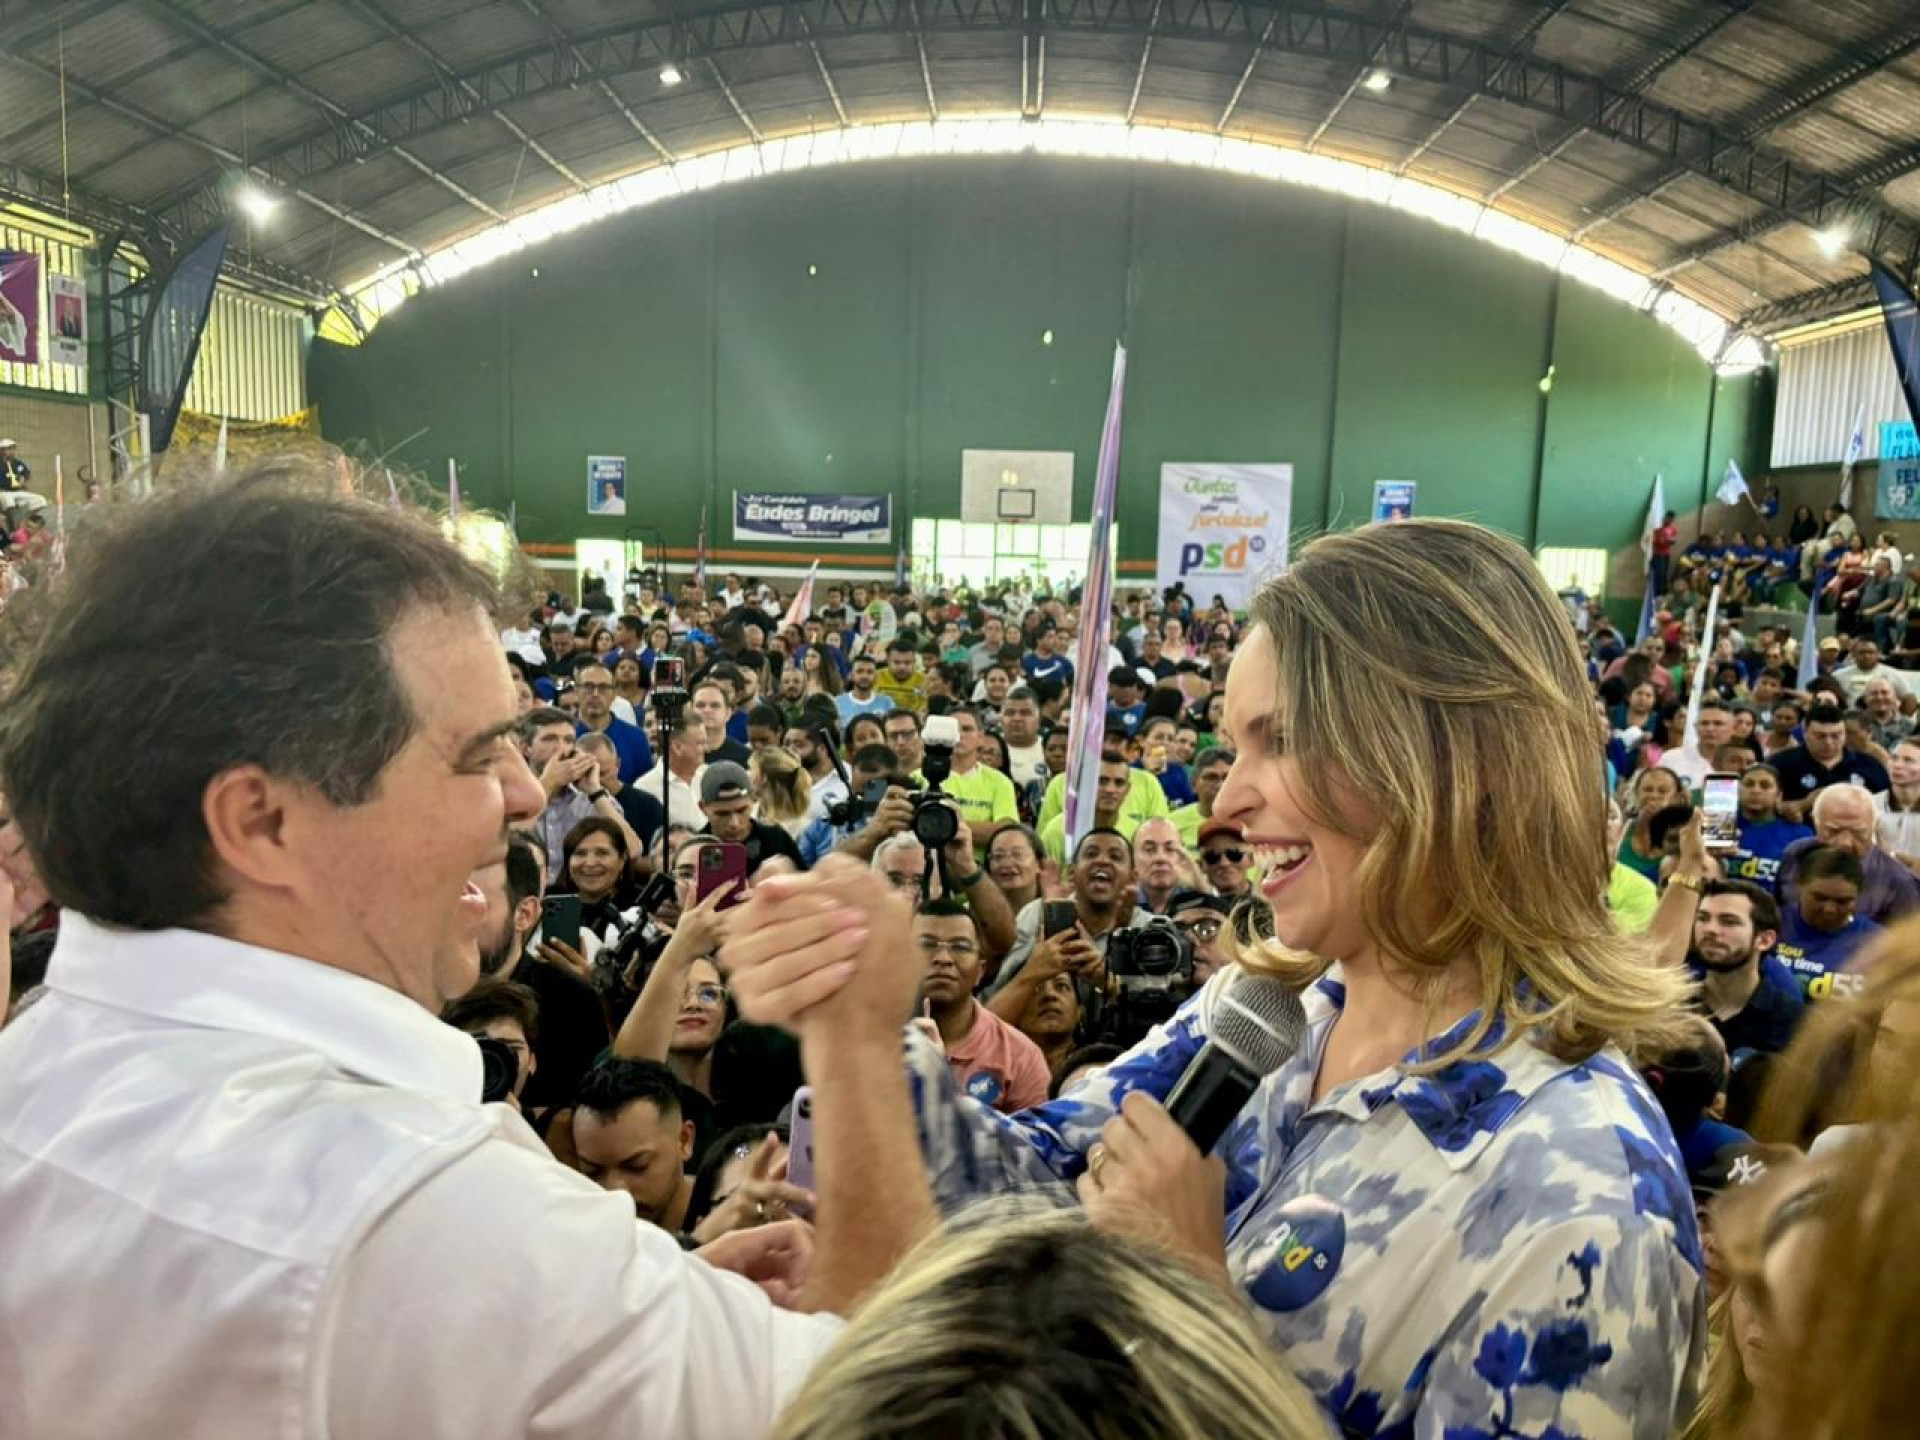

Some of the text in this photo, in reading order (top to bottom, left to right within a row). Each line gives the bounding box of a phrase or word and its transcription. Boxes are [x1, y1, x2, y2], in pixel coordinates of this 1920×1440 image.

[745, 503, 880, 525] Eudes Bringel
[1179, 535, 1248, 576] psd
[1793, 957, 1824, 973] time
